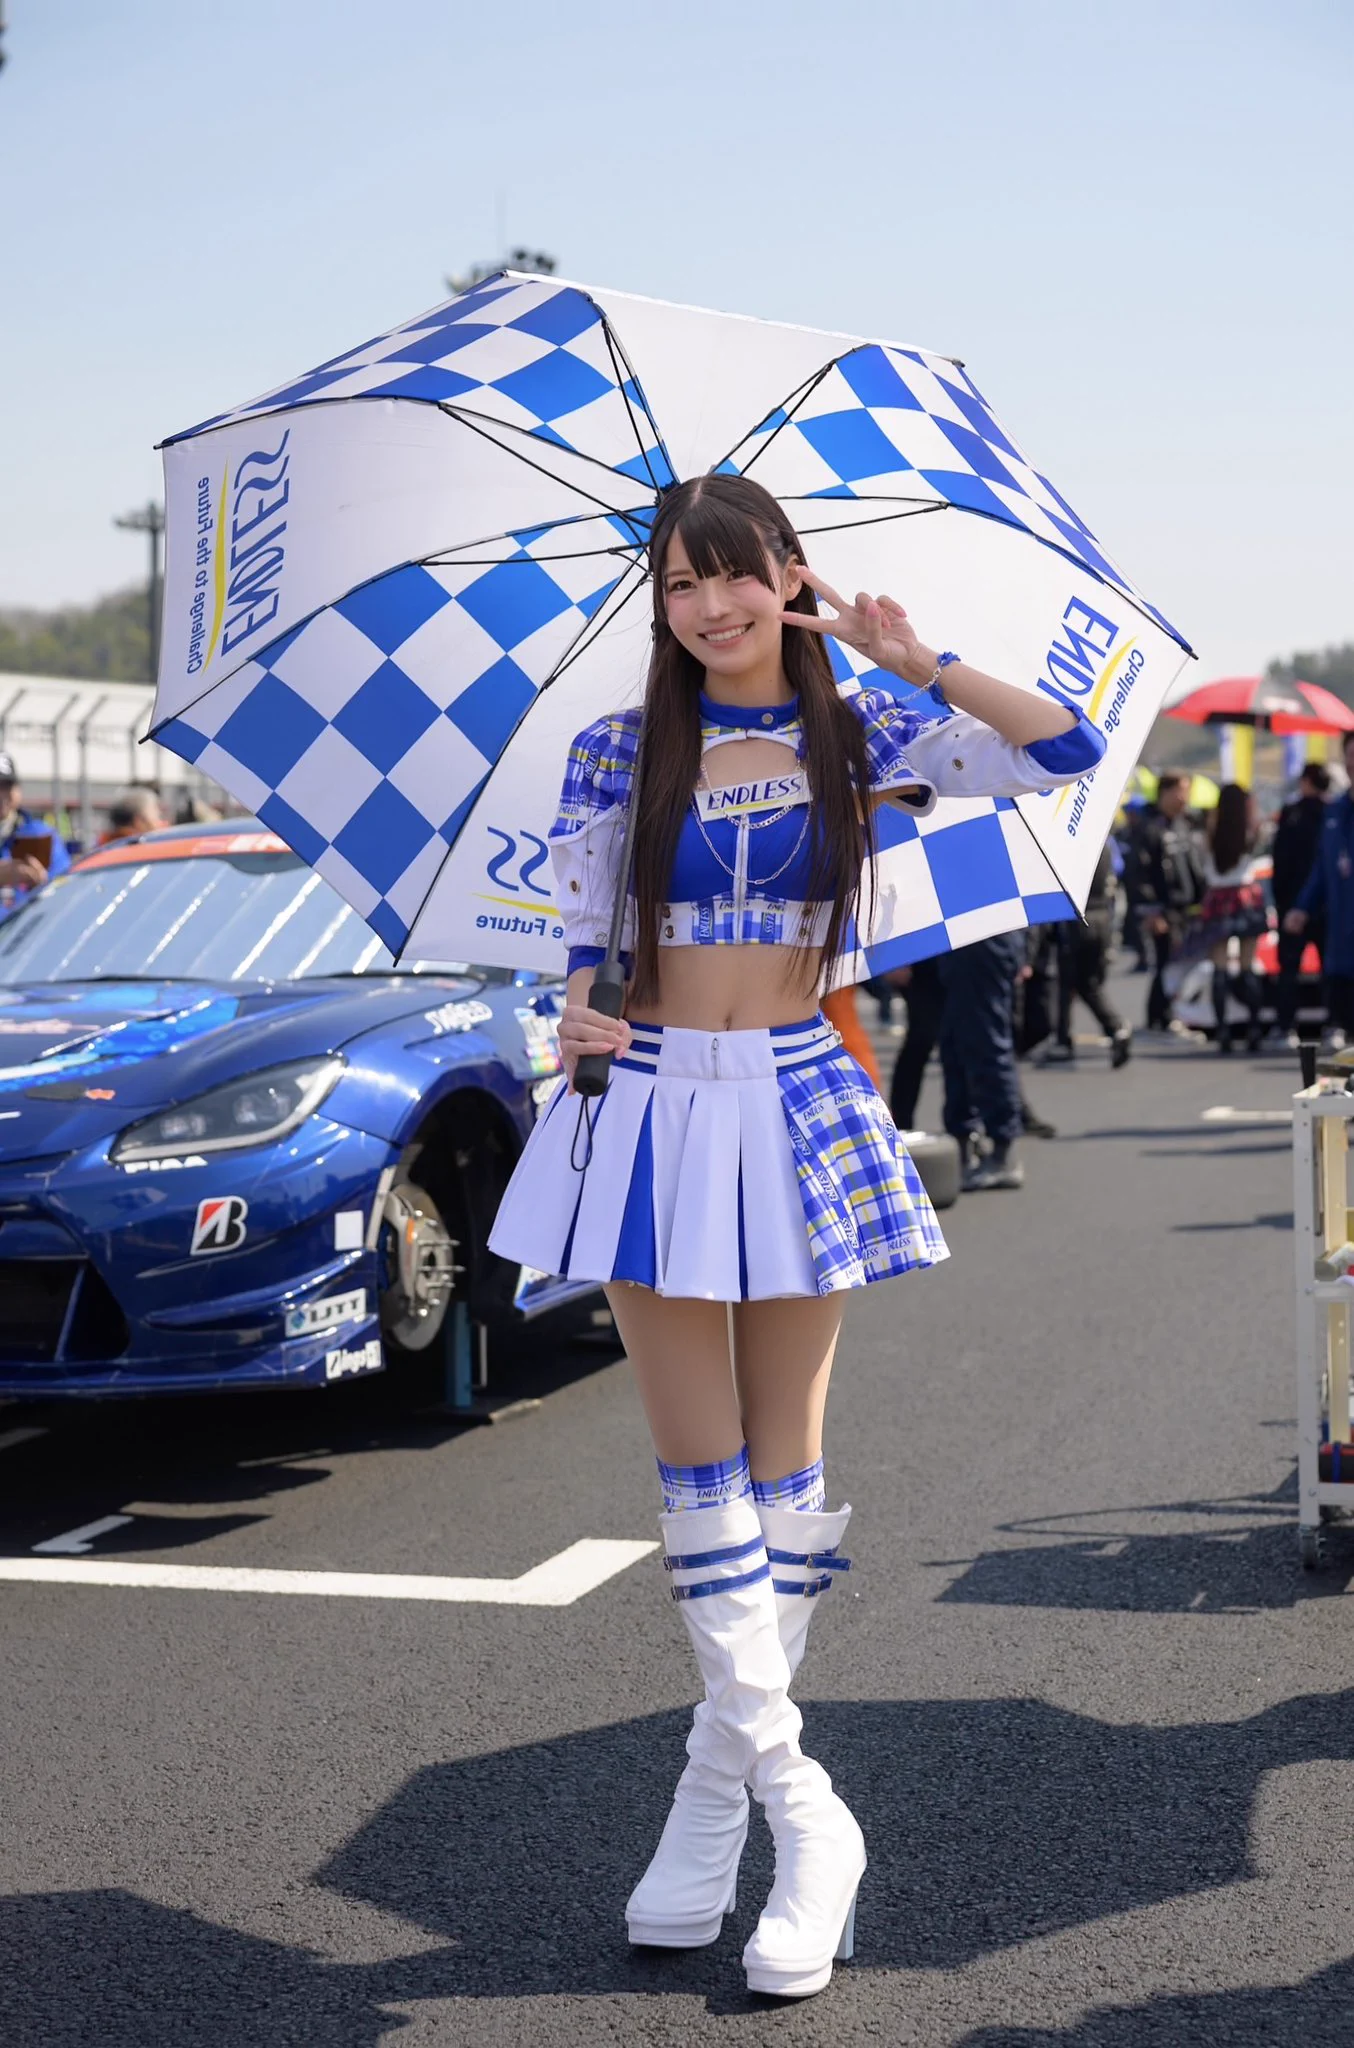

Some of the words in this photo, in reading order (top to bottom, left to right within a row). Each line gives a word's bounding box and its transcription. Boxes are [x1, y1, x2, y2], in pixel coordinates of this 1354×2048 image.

[706, 775, 801, 811] ENDLESS
[700, 906, 710, 938] ENDLESS
[814, 1170, 839, 1203] ENDLESS
[841, 1216, 860, 1249] ENDLESS
[697, 1484, 733, 1499] ENDLESS
